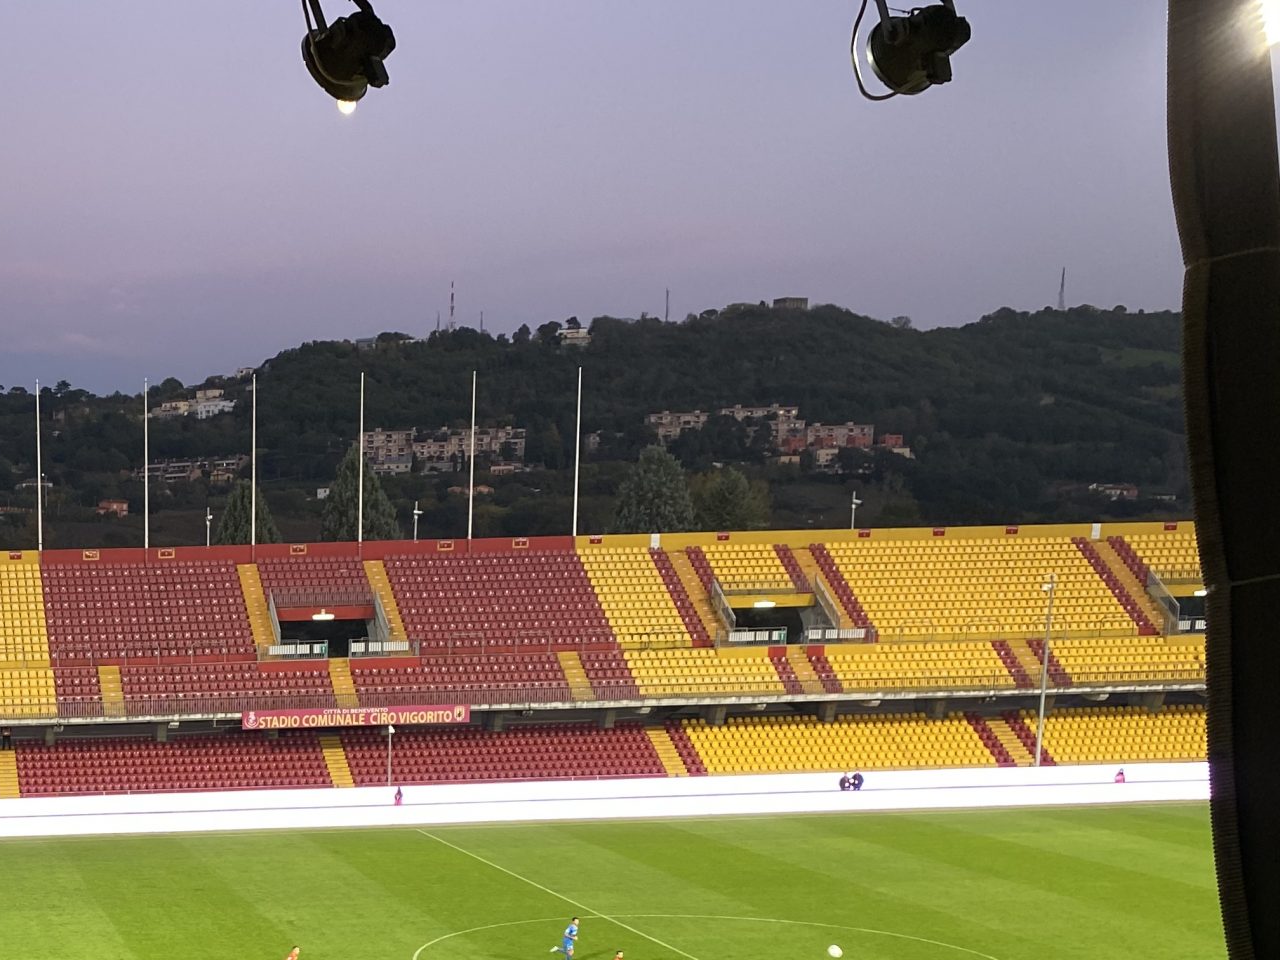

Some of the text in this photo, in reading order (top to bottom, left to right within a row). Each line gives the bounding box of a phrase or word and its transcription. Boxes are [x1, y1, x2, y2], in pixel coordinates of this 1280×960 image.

[259, 710, 452, 728] STADIO COMUNALE CIRO VIGORITO
